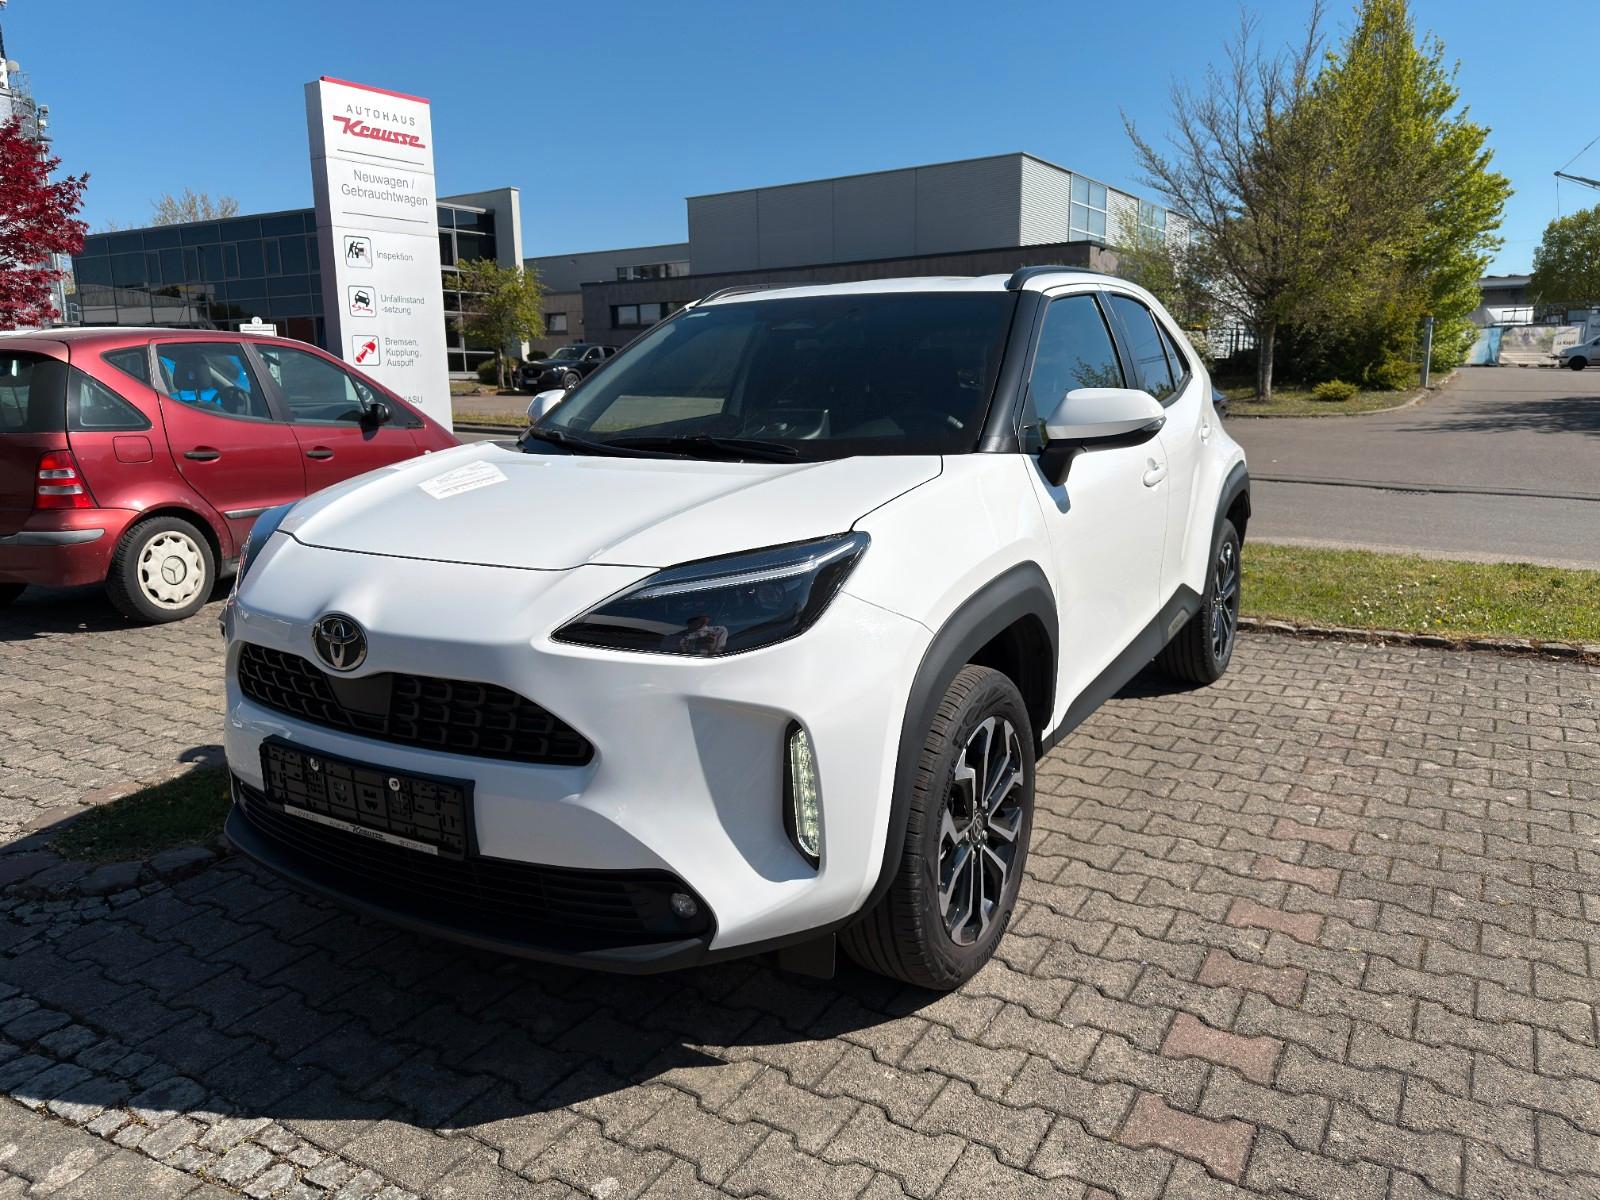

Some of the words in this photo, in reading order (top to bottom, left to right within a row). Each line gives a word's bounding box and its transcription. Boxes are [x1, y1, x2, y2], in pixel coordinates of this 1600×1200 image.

[346, 104, 416, 127] AUTOHAUS
[333, 115, 425, 149] Krausse
[353, 169, 409, 189] Neuwagen
[341, 183, 429, 208] Gebrauchtwagen
[376, 250, 414, 262] Inspektion
[380, 294, 425, 305] Unfallinstand
[387, 359, 414, 367] Auspuff
